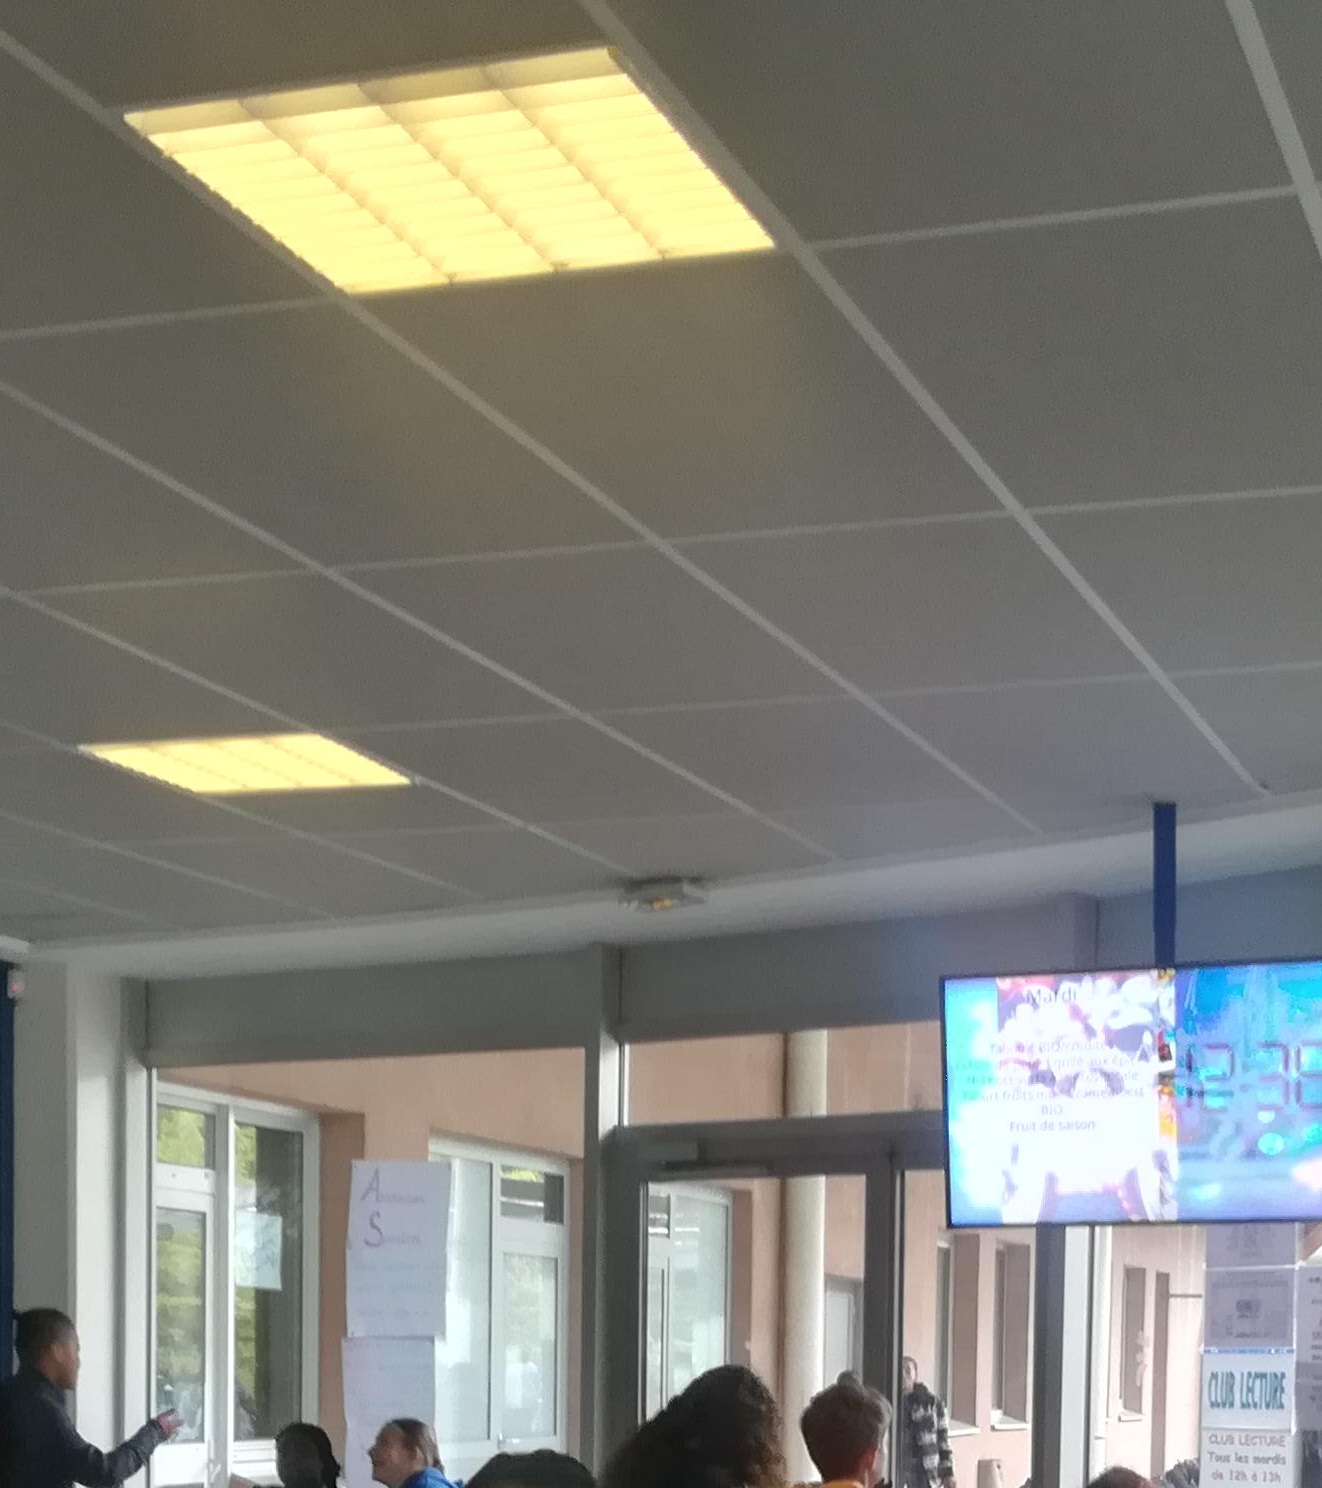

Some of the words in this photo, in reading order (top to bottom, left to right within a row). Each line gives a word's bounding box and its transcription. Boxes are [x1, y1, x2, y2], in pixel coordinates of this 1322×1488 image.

[1027, 986, 1077, 1003] Mardi
[1040, 1104, 1063, 1117] BIO
[1008, 1120, 1037, 1133] Fruit
[1040, 1120, 1055, 1132] de
[1058, 1119, 1096, 1131] saison
[1208, 1371, 1236, 1410] CLUB
[1240, 1371, 1286, 1410] LECTURE
[1208, 1433, 1235, 1446] CLUB
[1238, 1434, 1286, 1447] LECTURE
[1208, 1451, 1231, 1464] Tous
[1234, 1452, 1249, 1465] les
[1252, 1452, 1287, 1466] mardis
[1211, 1469, 1224, 1481] de
[1229, 1469, 1247, 1482] 12h
[1262, 1470, 1282, 1483] 13h
